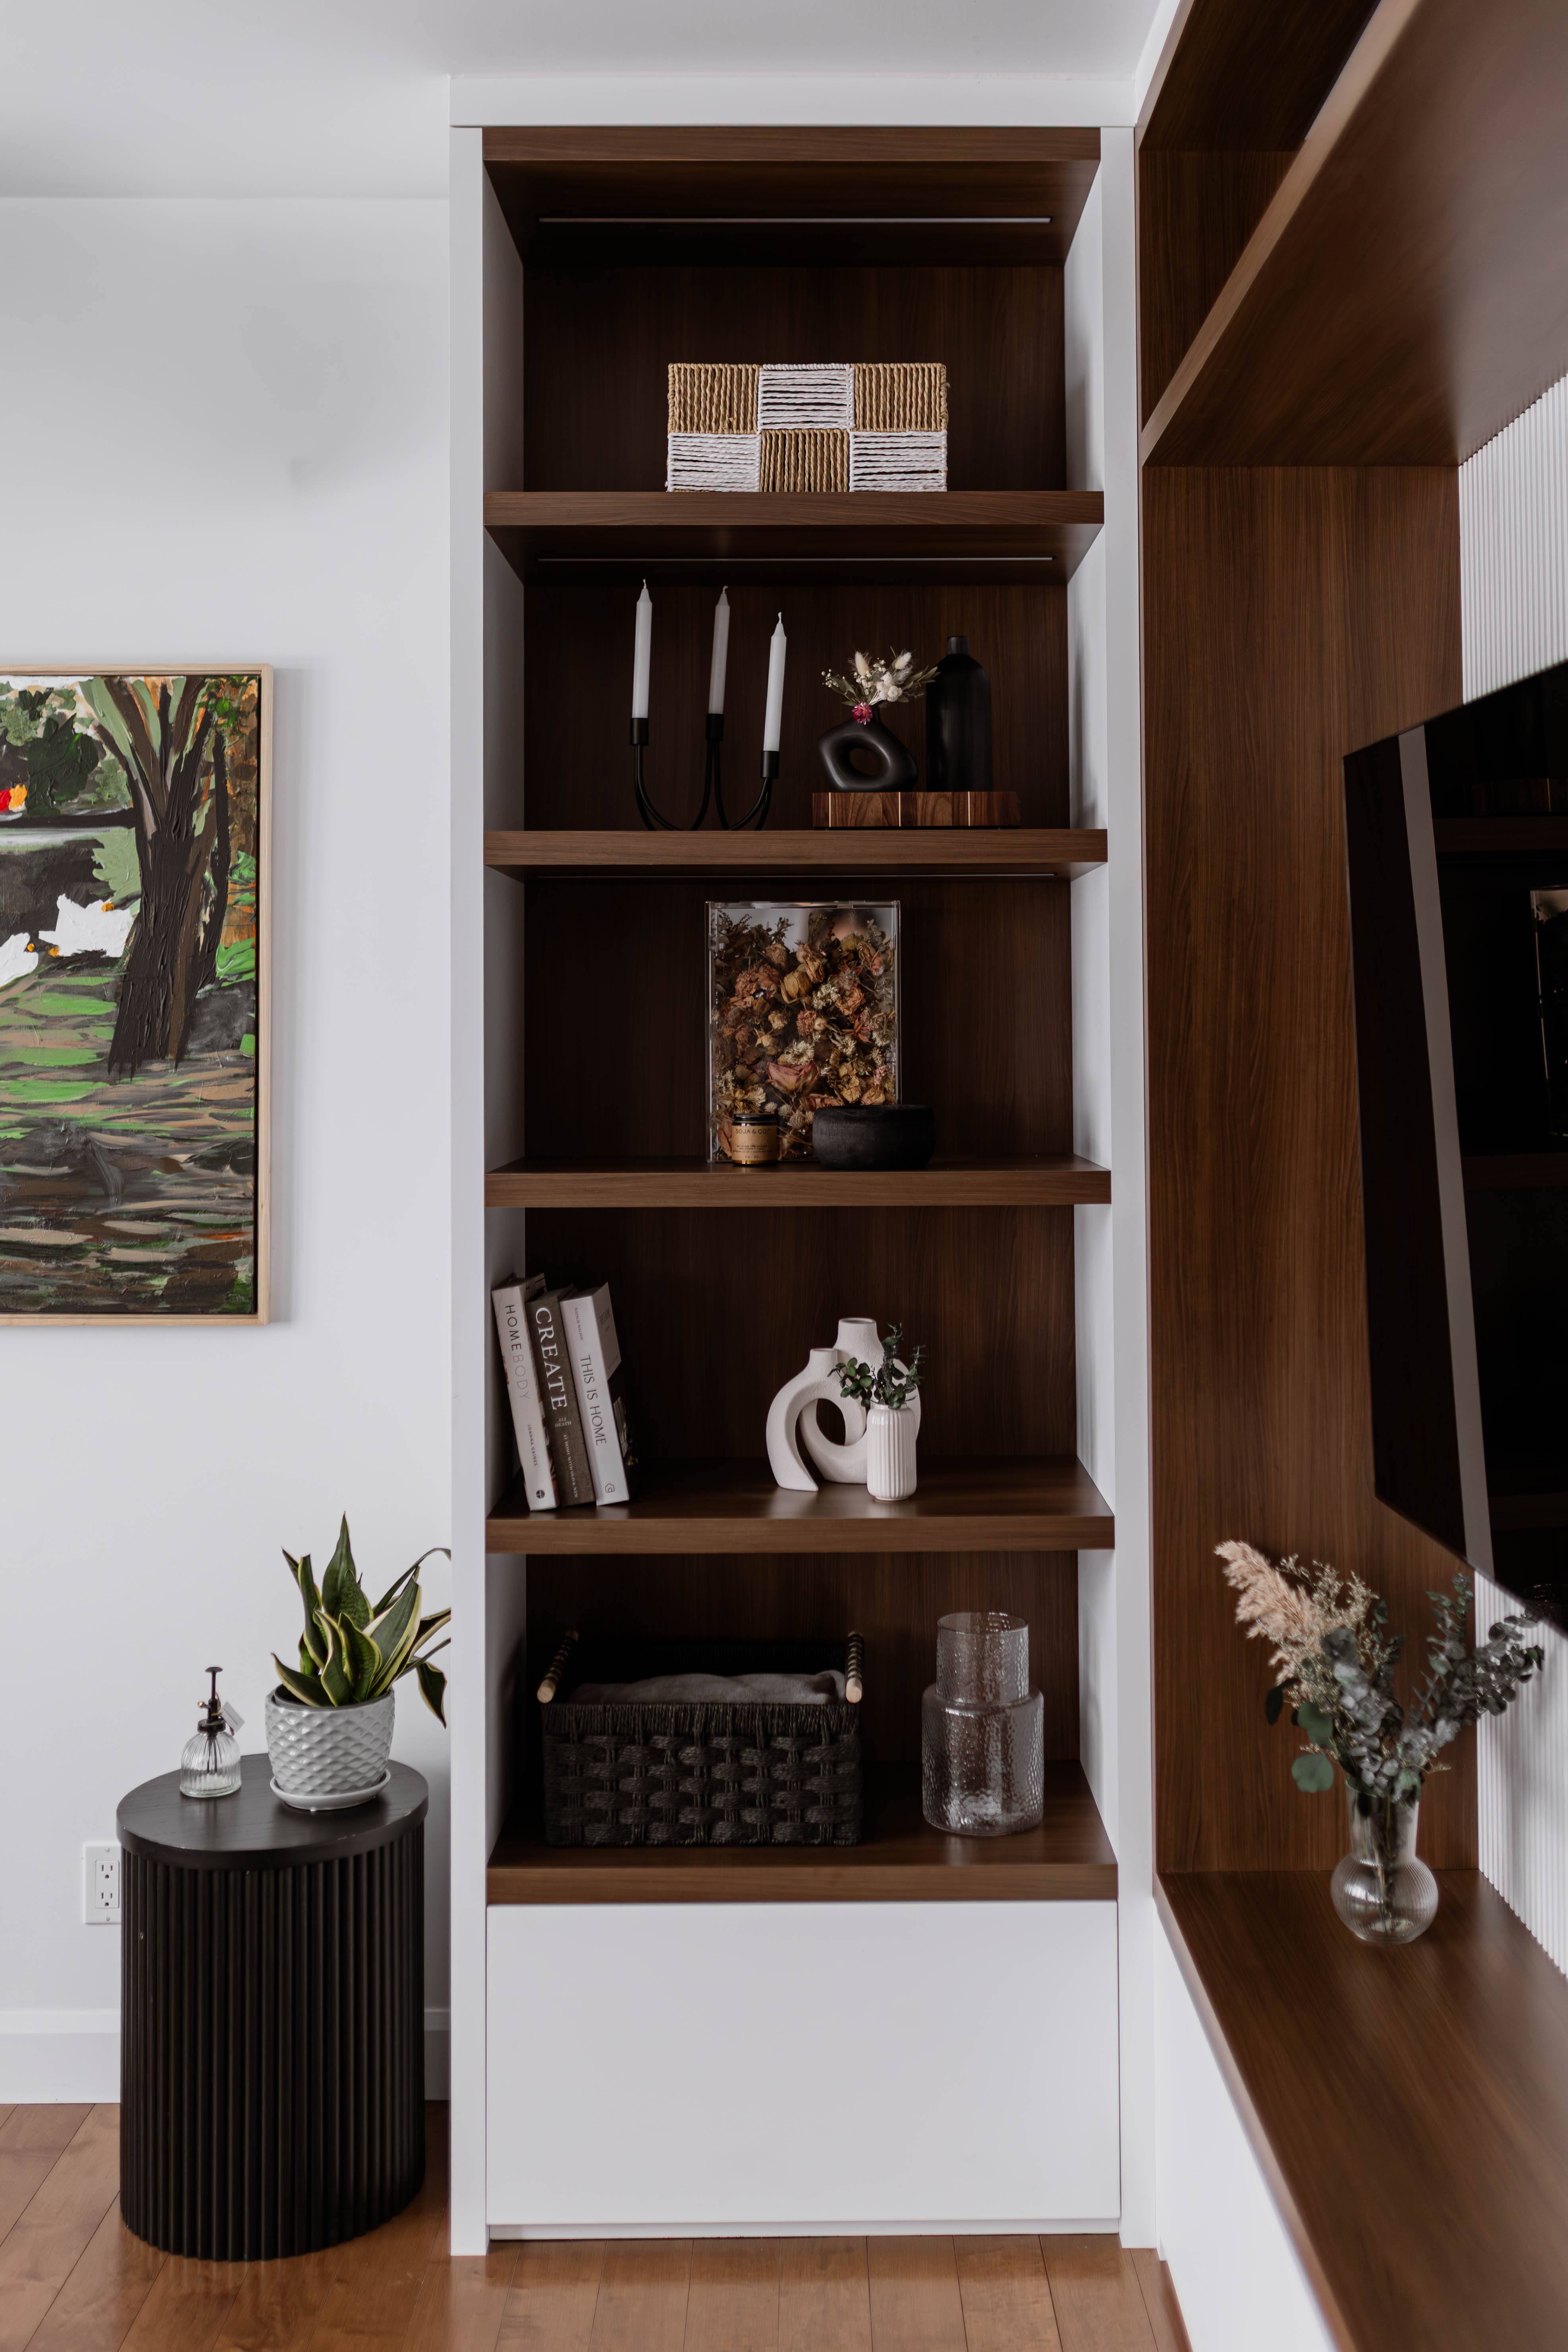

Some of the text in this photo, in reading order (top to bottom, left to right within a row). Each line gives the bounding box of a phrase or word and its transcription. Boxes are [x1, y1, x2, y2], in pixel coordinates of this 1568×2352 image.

[505, 1305, 530, 1399] HOMEBODY
[536, 1307, 567, 1410] CREATE
[580, 1355, 607, 1446] THIS IS HOME
